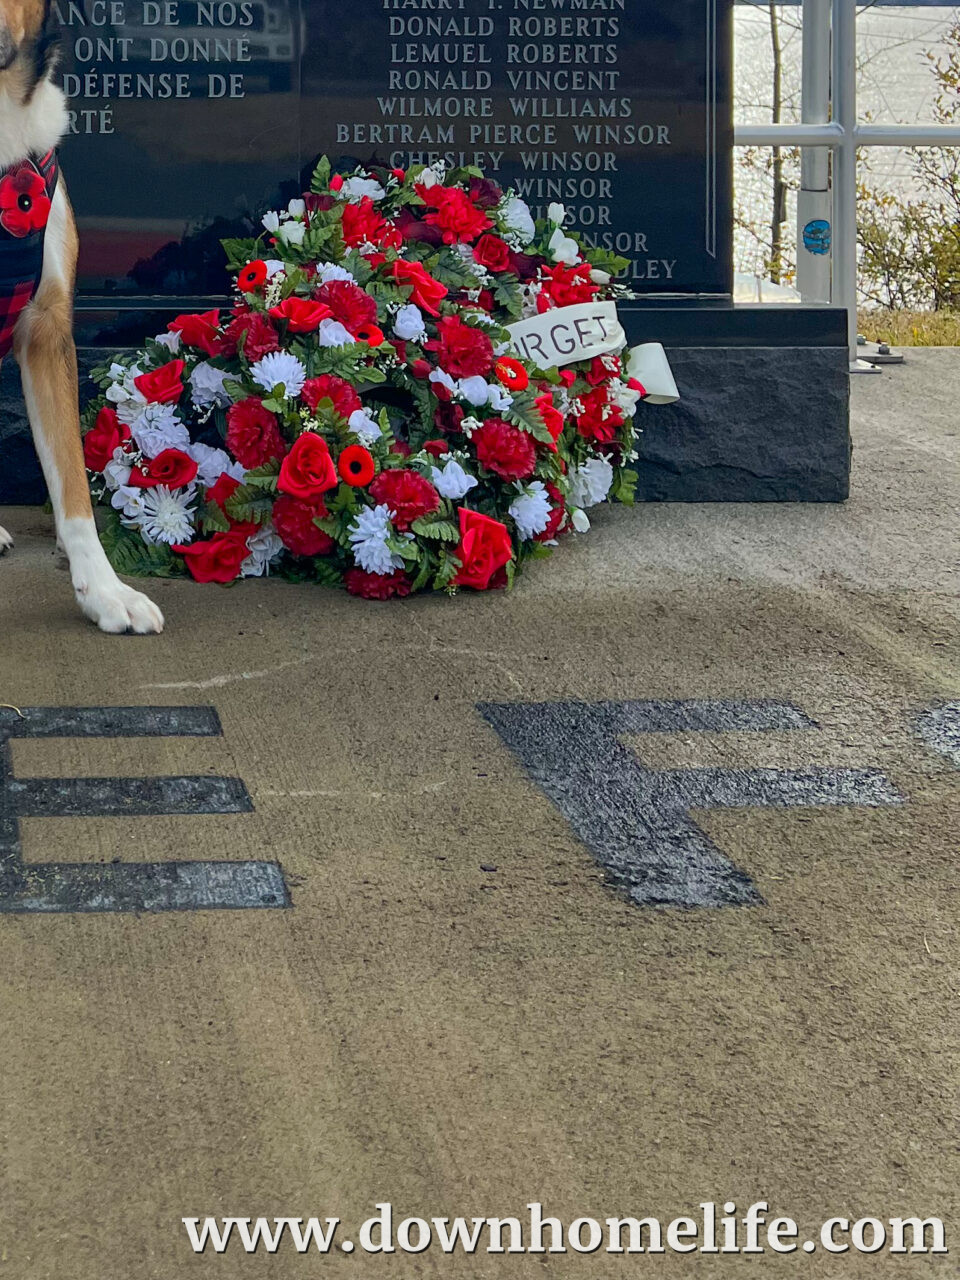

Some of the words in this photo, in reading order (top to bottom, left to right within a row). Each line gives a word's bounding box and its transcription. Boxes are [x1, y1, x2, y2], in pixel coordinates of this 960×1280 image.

[142, 1, 183, 26] DE
[195, 1, 255, 26] NOS
[388, 16, 495, 37] DONALD
[508, 17, 621, 38] ROBERTS
[74, 37, 134, 63] ONT
[149, 32, 253, 63] DONNÉ
[389, 43, 492, 64] LEMUEL
[506, 43, 619, 65] ROBERTS
[63, 68, 193, 99] DÉFENSE
[207, 73, 246, 99] DE
[388, 70, 492, 91] RONALD
[506, 70, 621, 91] VINCENT
[376, 97, 494, 118] WILMORE
[508, 97, 633, 118] WILLIAMS
[335, 123, 455, 144] BERTRAM
[469, 124, 557, 145] PIERCE
[572, 124, 672, 145] WINSOR
[519, 151, 618, 172] WINSOR
[513, 177, 613, 199] WINSOR
[583, 231, 649, 253] NSOR
